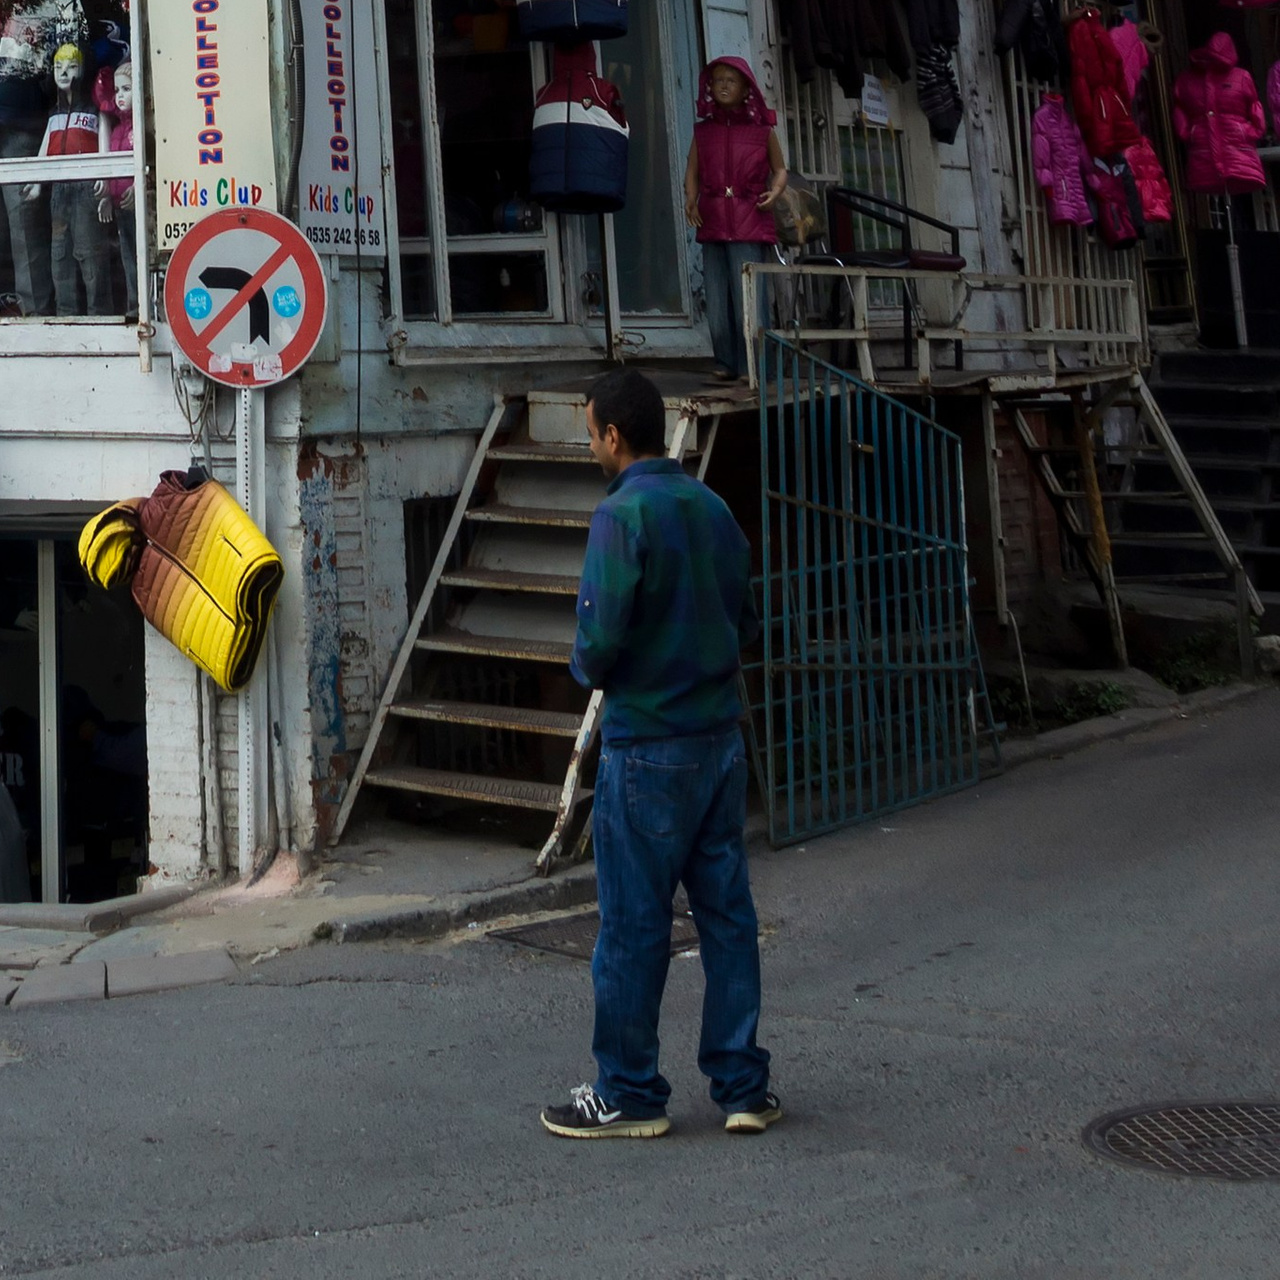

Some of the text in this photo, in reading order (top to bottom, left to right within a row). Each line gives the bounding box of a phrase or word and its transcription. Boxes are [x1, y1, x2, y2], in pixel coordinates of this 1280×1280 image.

[170, 177, 262, 207] Kids Clup
[309, 184, 339, 213] Kids
[306, 226, 330, 243] 0535
[333, 228, 351, 244] 242
[368, 230, 380, 246] 58
